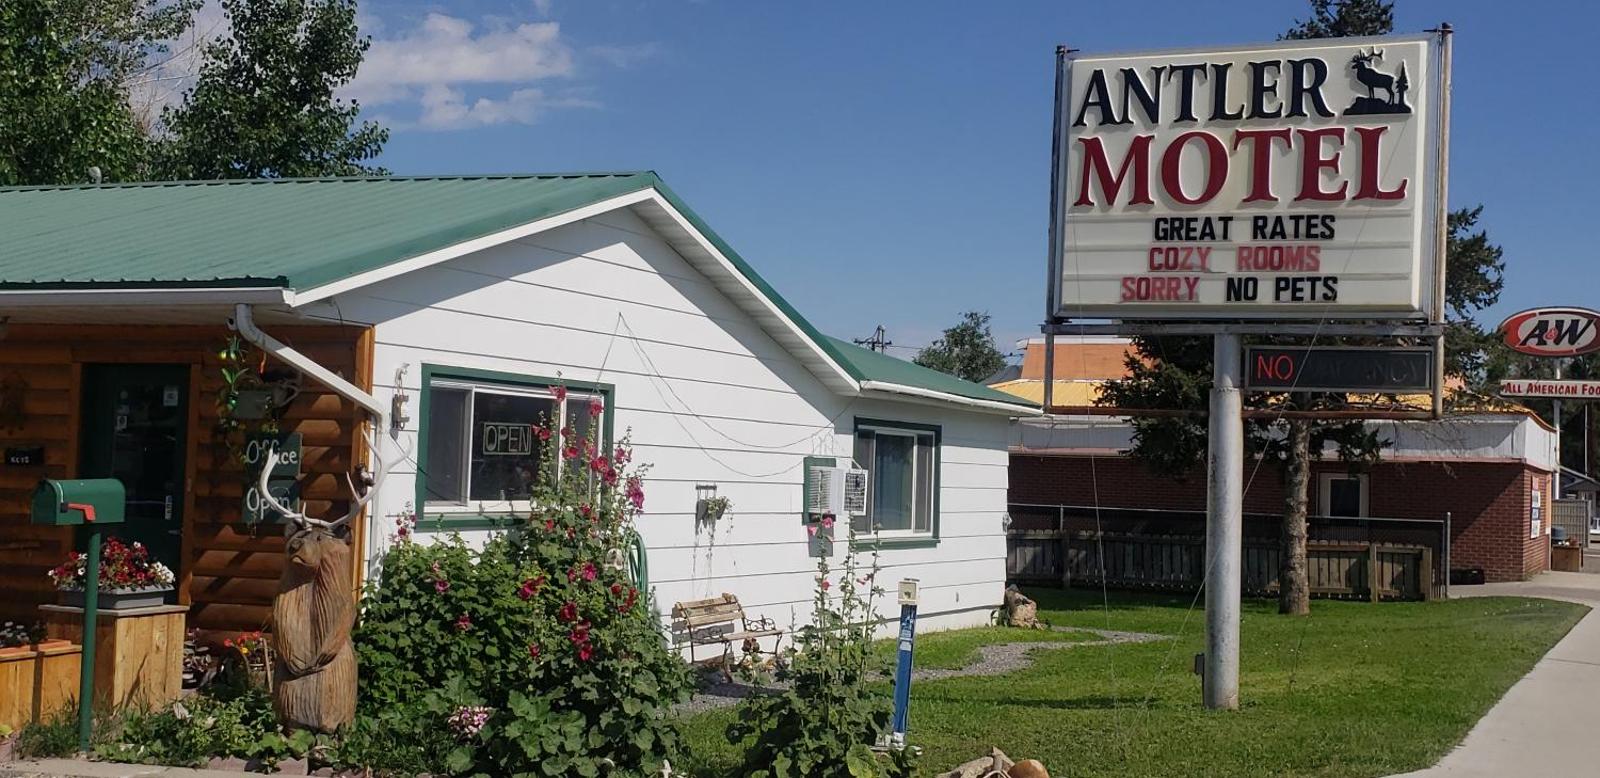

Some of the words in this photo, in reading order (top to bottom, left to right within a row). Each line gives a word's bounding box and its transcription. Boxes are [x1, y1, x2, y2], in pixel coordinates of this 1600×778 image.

[1073, 57, 1335, 127] ANTLER
[1073, 126, 1407, 206] MOTEL
[1154, 216, 1234, 241] GREAT
[1252, 214, 1336, 240] RATES
[1149, 246, 1213, 271] COZY
[1237, 245, 1321, 272] ROOMS
[1121, 276, 1200, 301] SORRY
[1226, 276, 1258, 301] NO
[1275, 276, 1338, 301] PETS
[1519, 318, 1596, 346] A&W
[1257, 354, 1294, 380] NO
[1504, 382, 1523, 394] ALL
[1526, 382, 1578, 395] AMERICAN
[486, 425, 530, 452] OPEN
[246, 487, 294, 521] Opn
